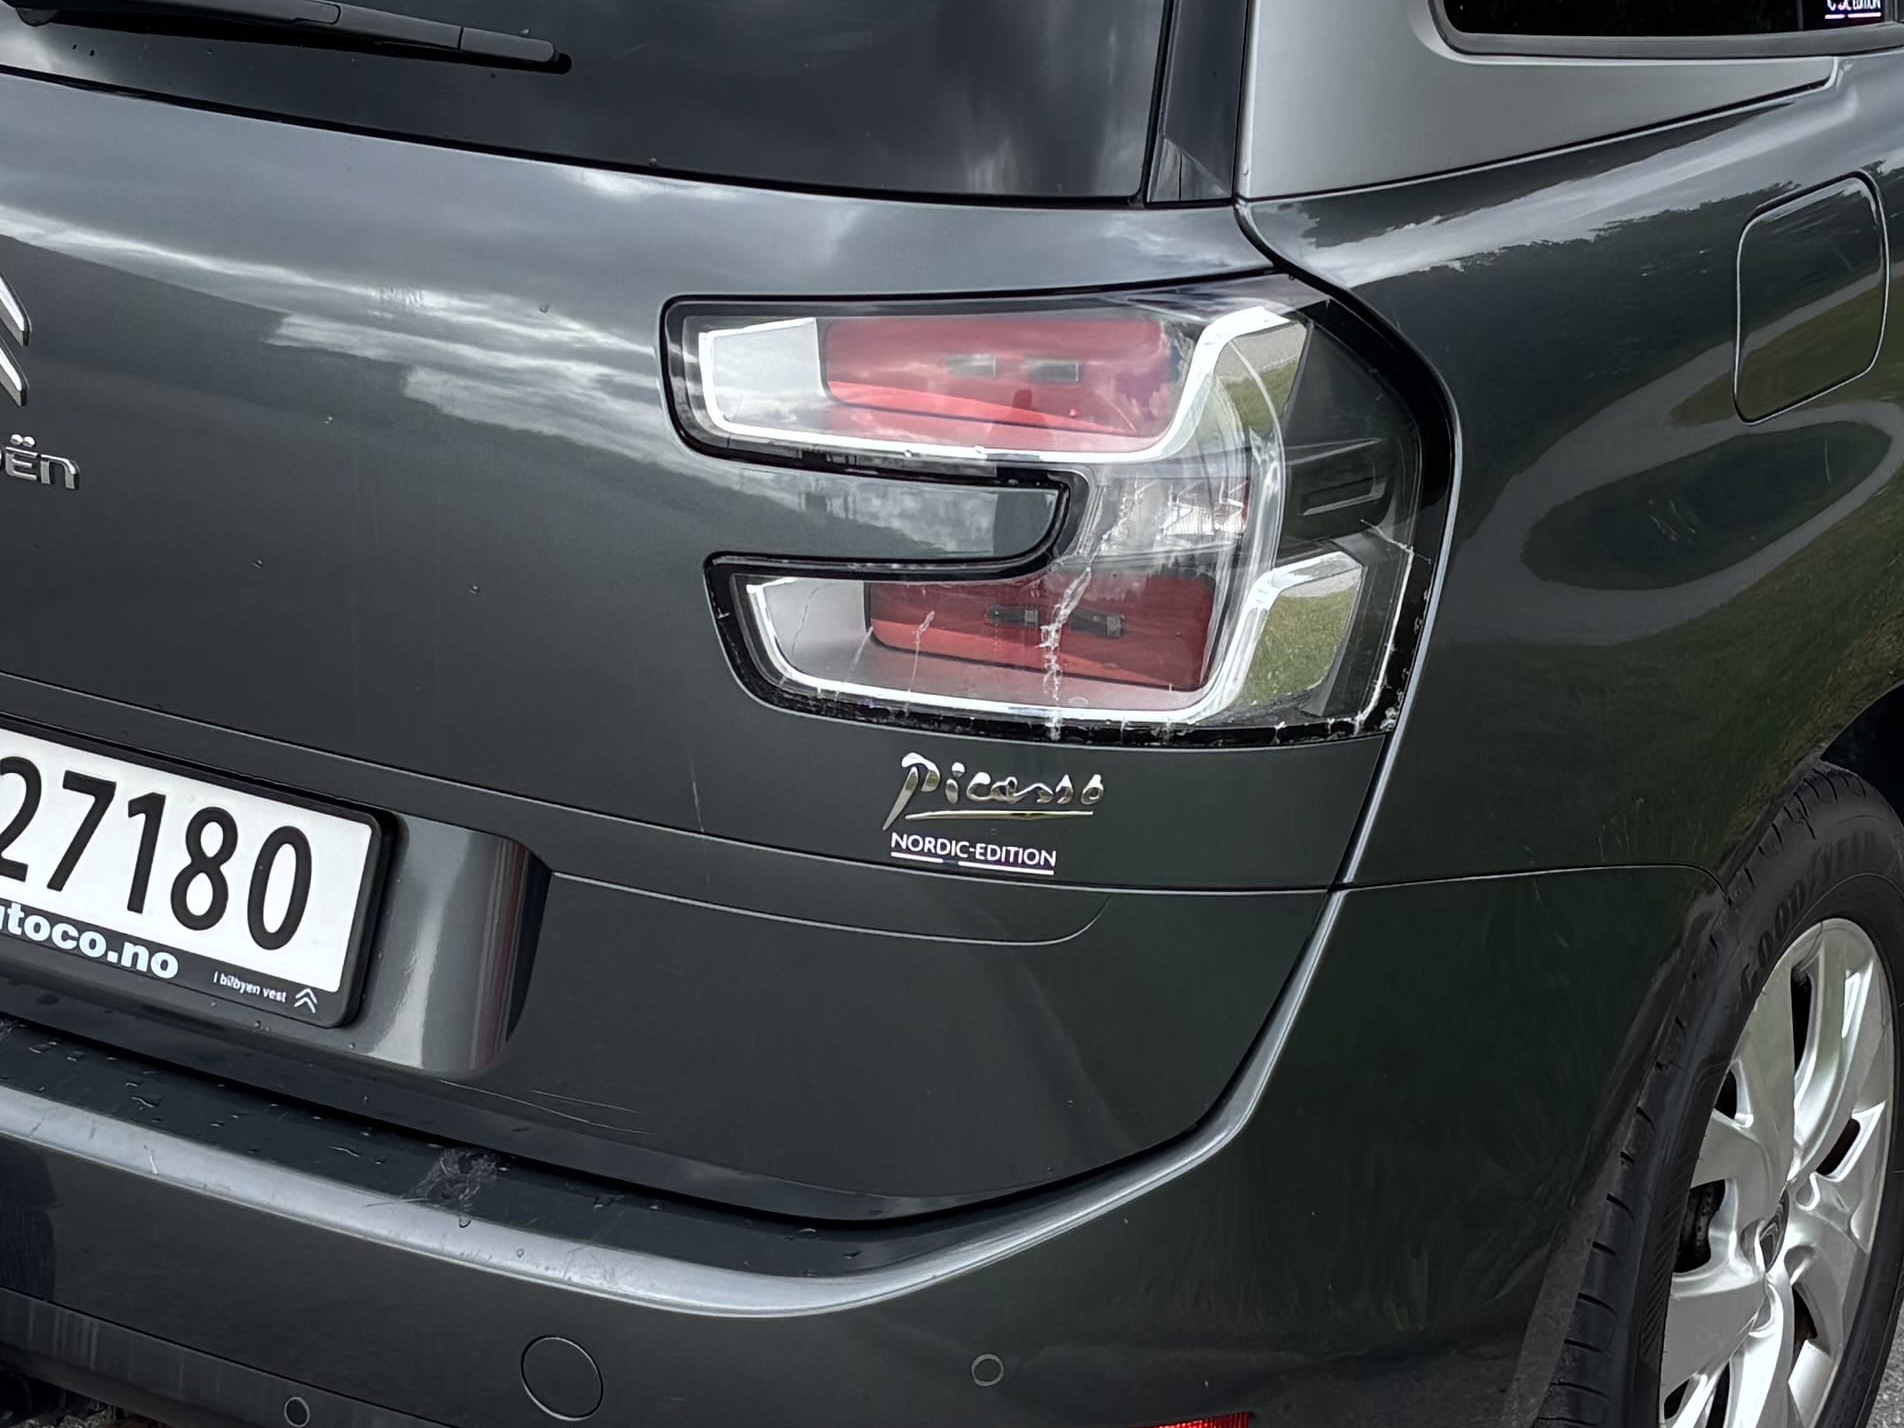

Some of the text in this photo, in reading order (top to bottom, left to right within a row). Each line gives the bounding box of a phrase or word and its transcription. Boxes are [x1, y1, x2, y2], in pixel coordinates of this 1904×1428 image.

[882, 752, 1105, 831] Picasso
[890, 832, 1057, 868] NORDIC-EDITION
[220, 973, 261, 994] bilbyen
[262, 987, 287, 1003] vest
